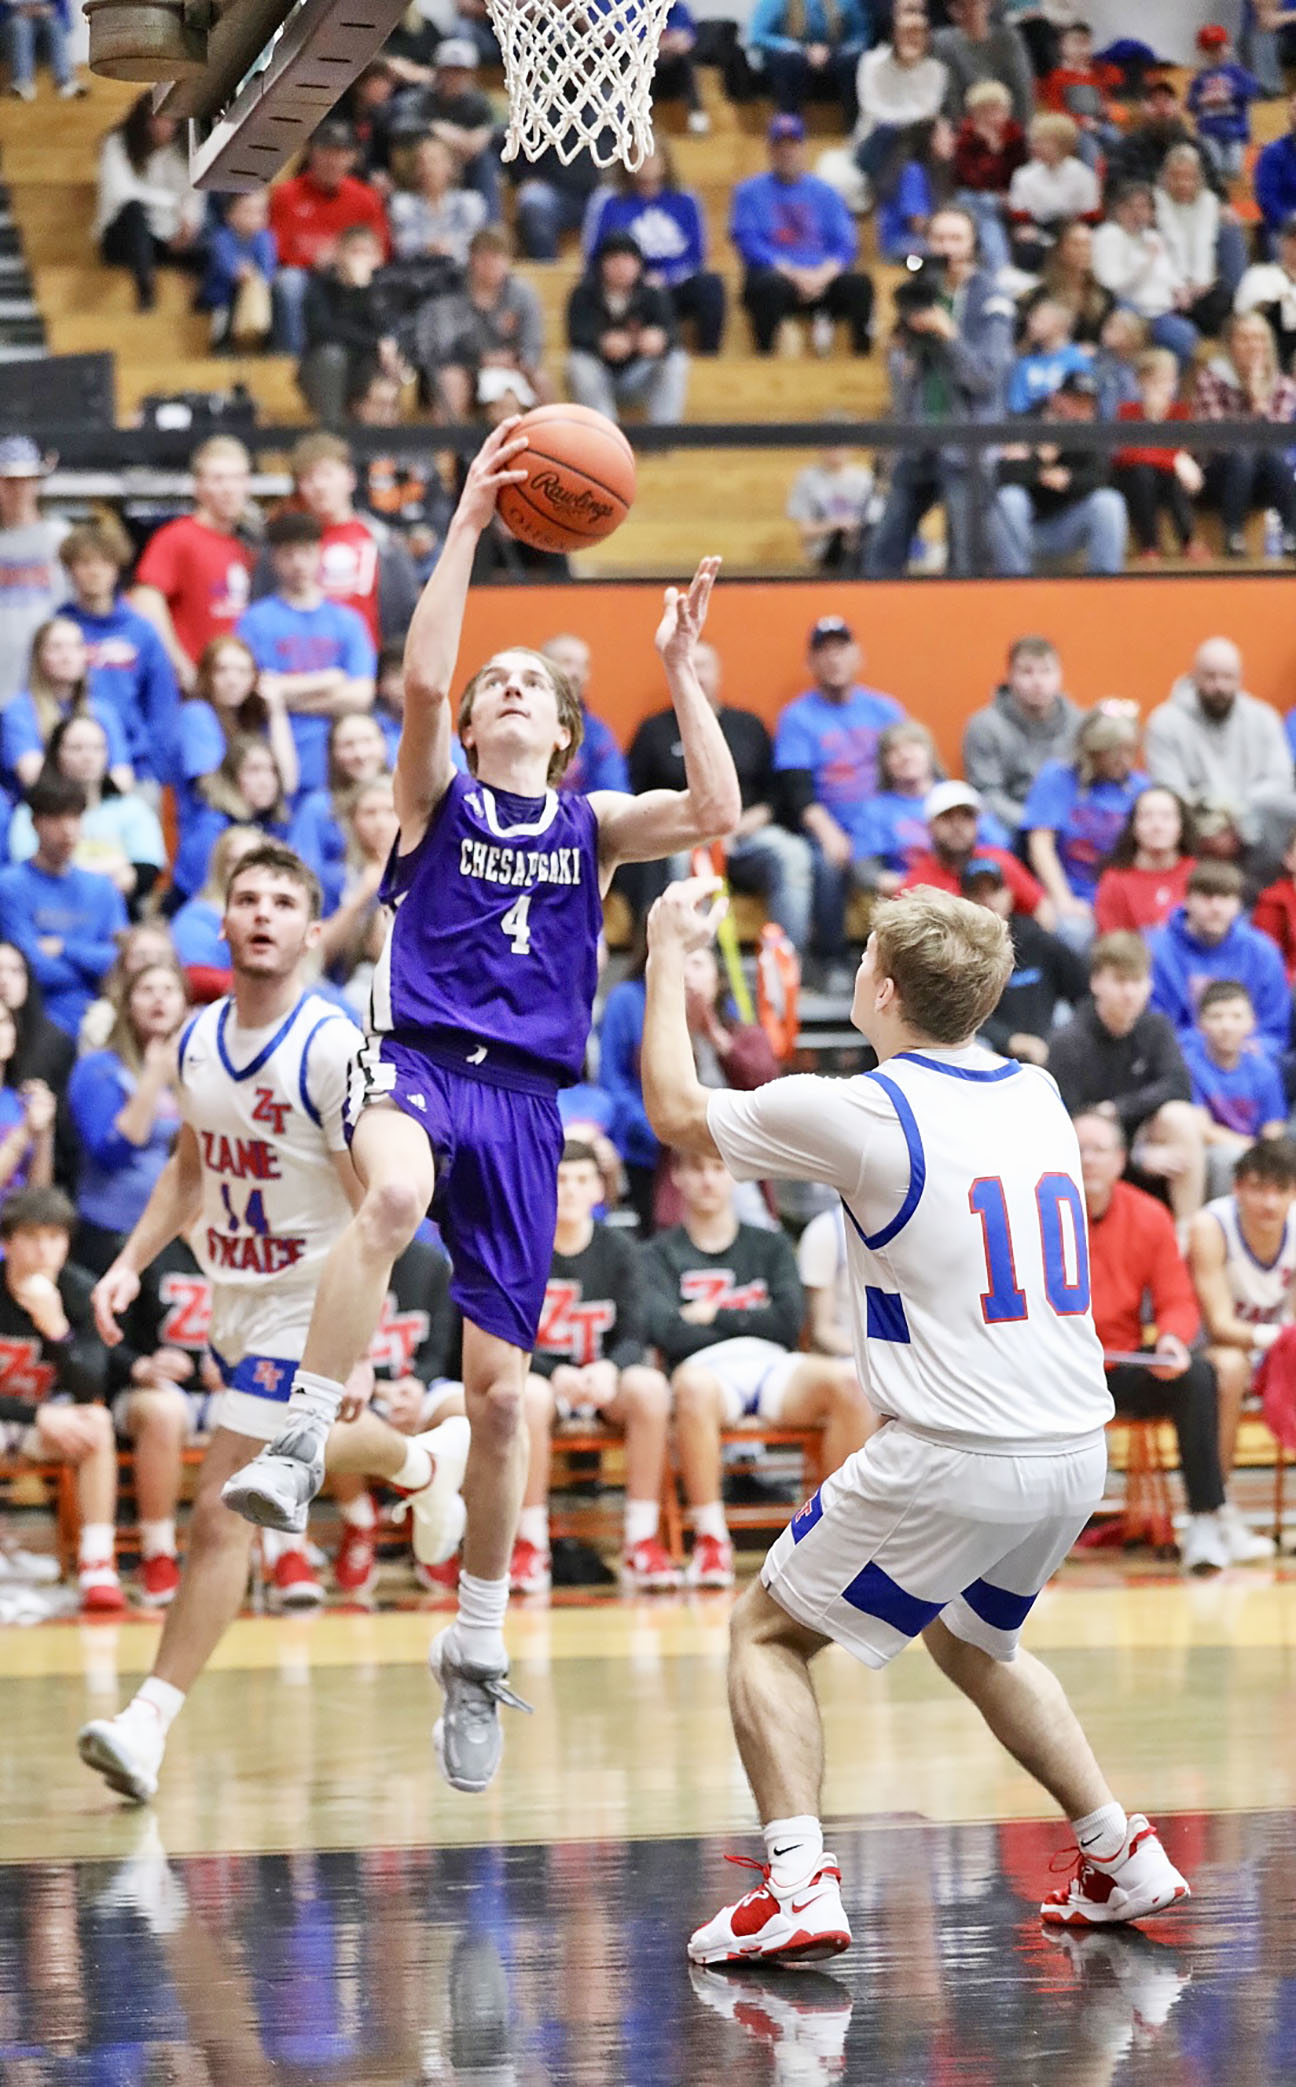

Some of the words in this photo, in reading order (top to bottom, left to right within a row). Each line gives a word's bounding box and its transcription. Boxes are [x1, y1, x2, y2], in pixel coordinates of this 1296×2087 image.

[530, 471, 614, 524] Rawlings
[500, 894, 532, 955] 4
[251, 1087, 293, 1135] ZT
[201, 1130, 282, 1180] ZANE
[968, 1172, 1091, 1324] 10
[158, 1271, 213, 1350] Z
